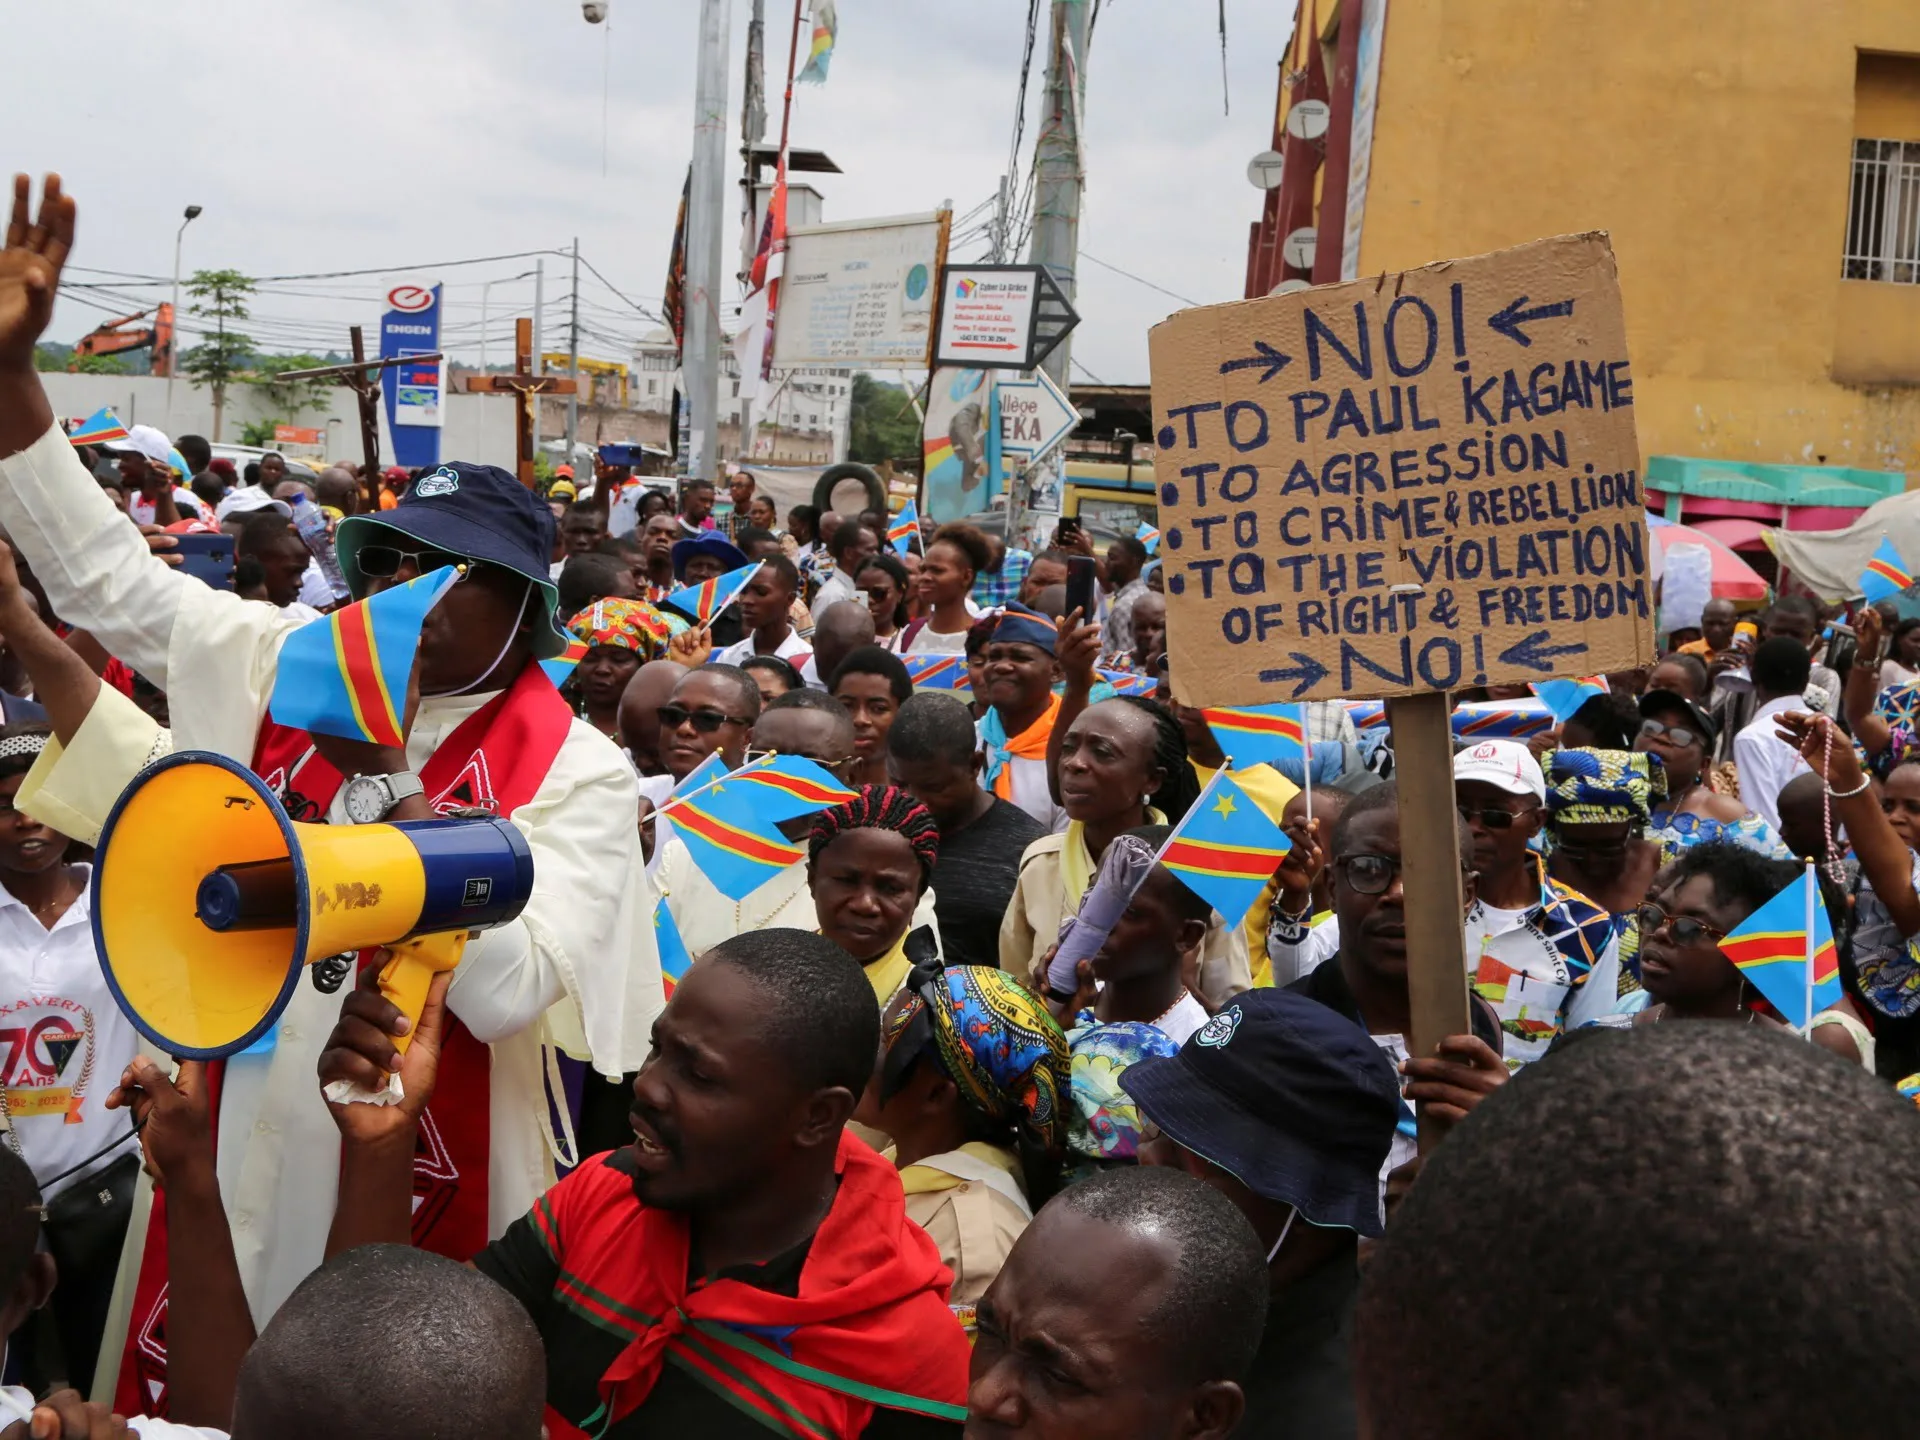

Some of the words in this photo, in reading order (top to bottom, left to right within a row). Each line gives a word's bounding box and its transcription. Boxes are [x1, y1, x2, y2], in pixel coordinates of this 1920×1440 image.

[386, 324, 432, 335] ENGEN
[1304, 283, 1470, 381] NO!
[1167, 400, 1269, 453] TO
[1288, 384, 1440, 443] PAUL
[1462, 360, 1634, 428] KAGAME
[1180, 462, 1260, 508] TO
[1191, 511, 1258, 551] TO
[1188, 553, 1266, 599] TO
[1278, 551, 1386, 594] THE
[1221, 604, 1283, 645] OF
[1478, 578, 1649, 627] FREEDOM
[1340, 633, 1488, 692] NO!
[43, 1032, 84, 1042] CARITAS
[16, 1068, 57, 1087] Ans
